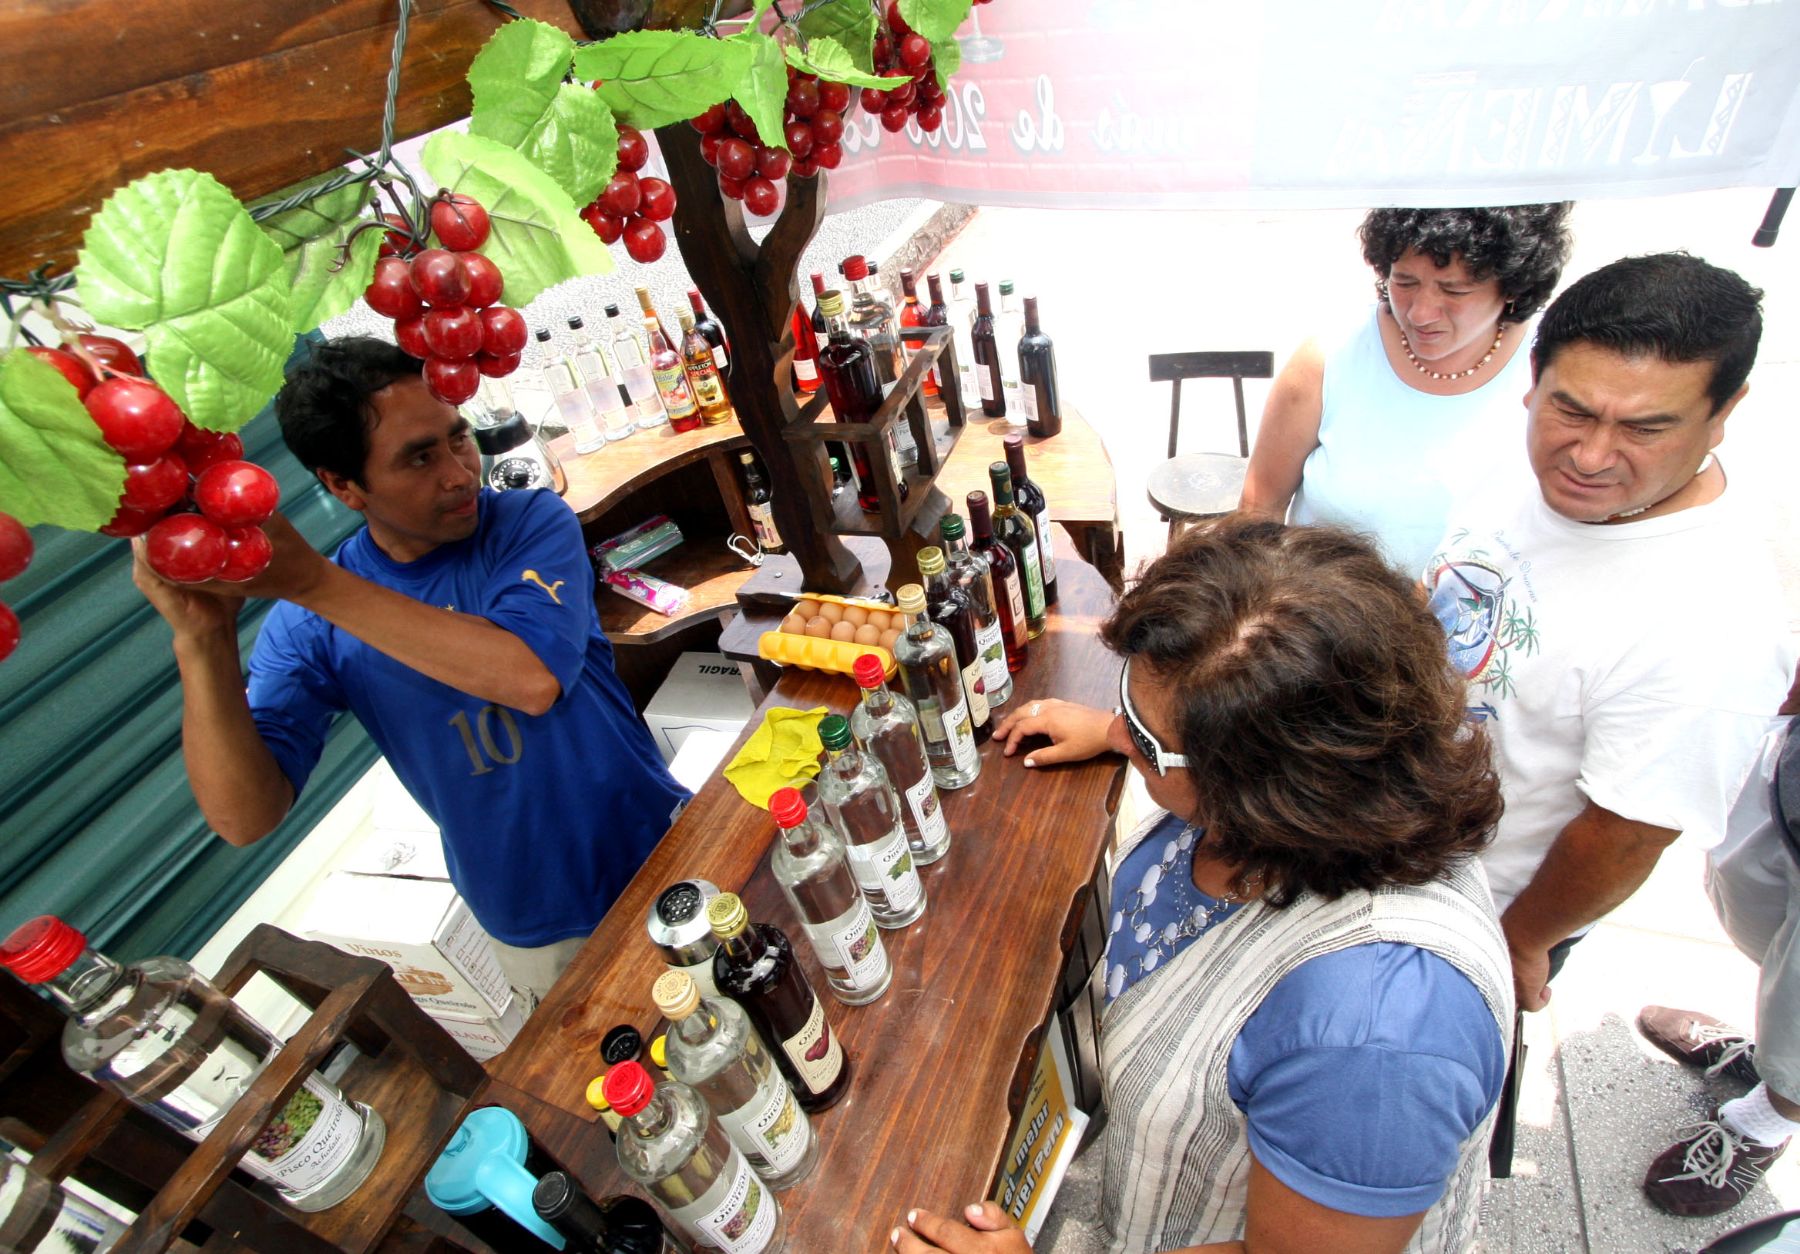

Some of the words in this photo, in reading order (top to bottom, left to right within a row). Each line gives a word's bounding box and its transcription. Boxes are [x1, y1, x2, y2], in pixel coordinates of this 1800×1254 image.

[448, 705, 524, 776] 10
[345, 942, 403, 959] Vinos
[277, 1154, 312, 1178] Pisco
[312, 1103, 344, 1155] Queirolo
[310, 1132, 342, 1170] Acholado
[1015, 1100, 1049, 1168] mejor
[1033, 1112, 1065, 1176] Perú
